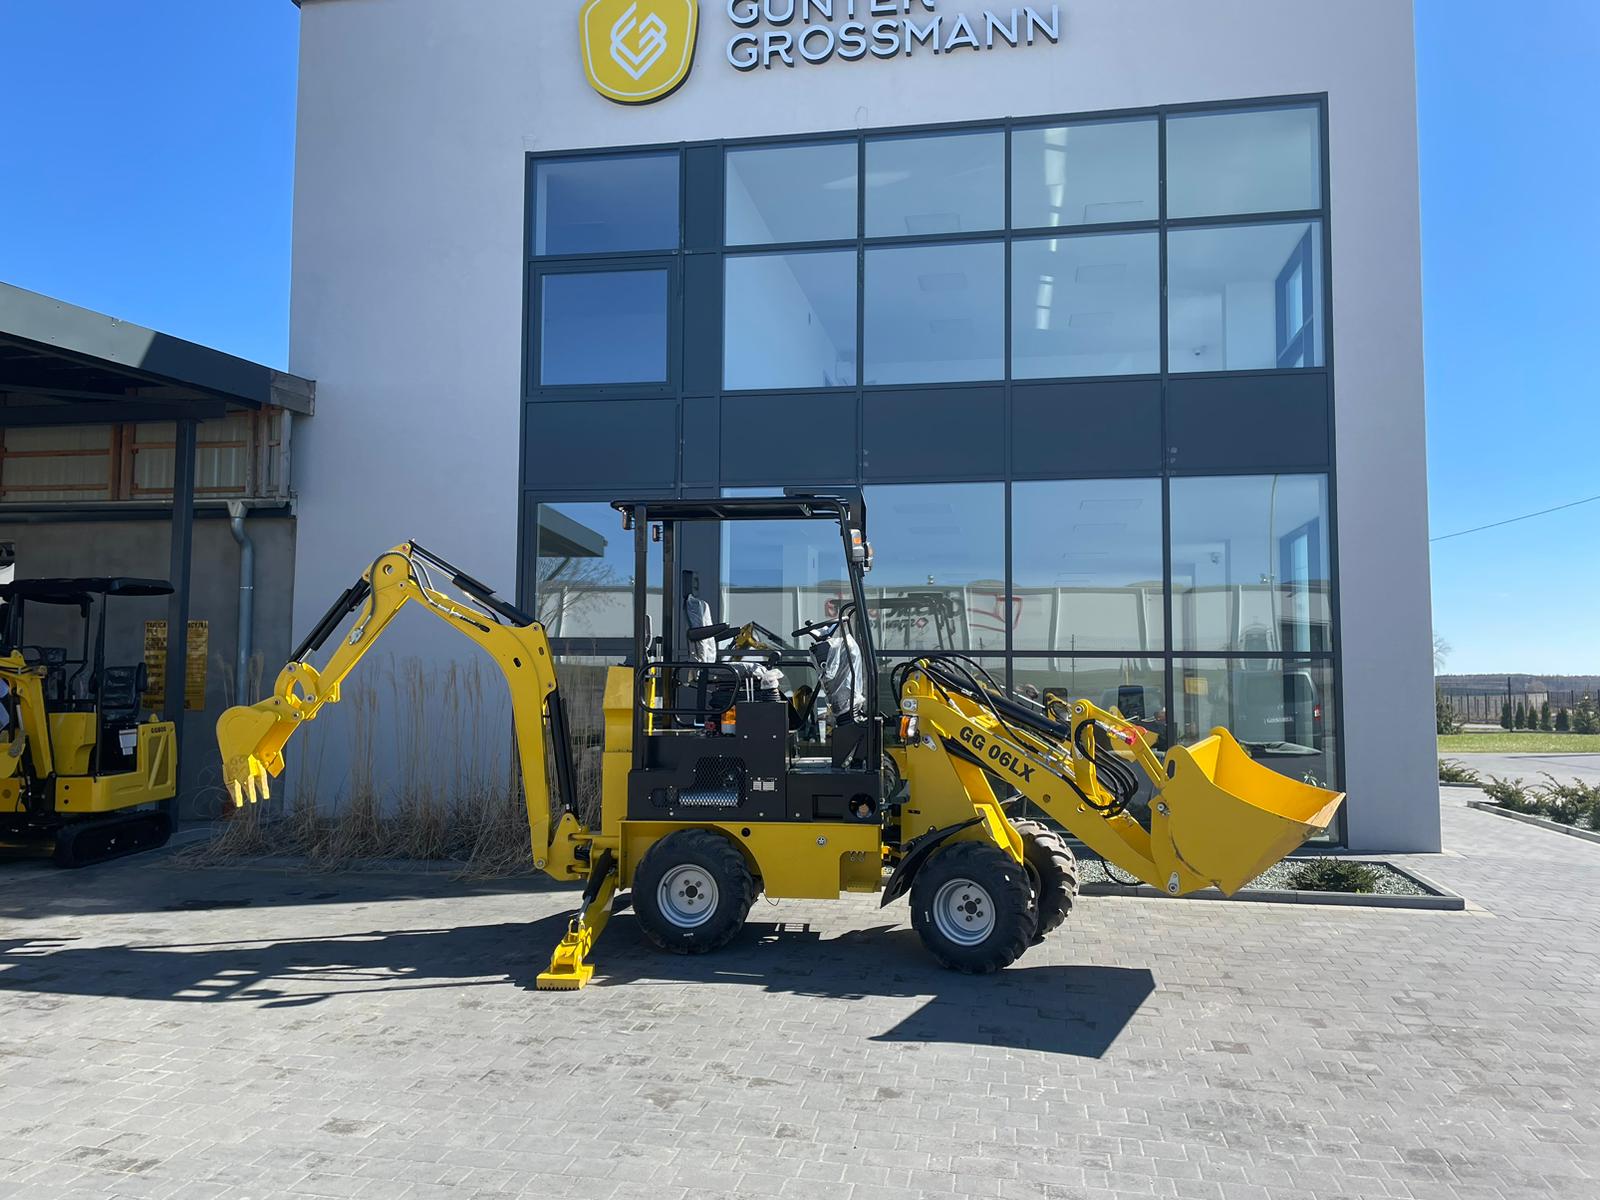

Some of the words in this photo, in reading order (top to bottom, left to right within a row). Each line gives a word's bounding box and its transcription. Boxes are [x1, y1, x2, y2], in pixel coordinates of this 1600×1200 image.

[726, 6, 1059, 70] GROSSMANN
[727, 0, 935, 26] GUN
[960, 726, 986, 751] GG
[988, 744, 1035, 783] 06LX
